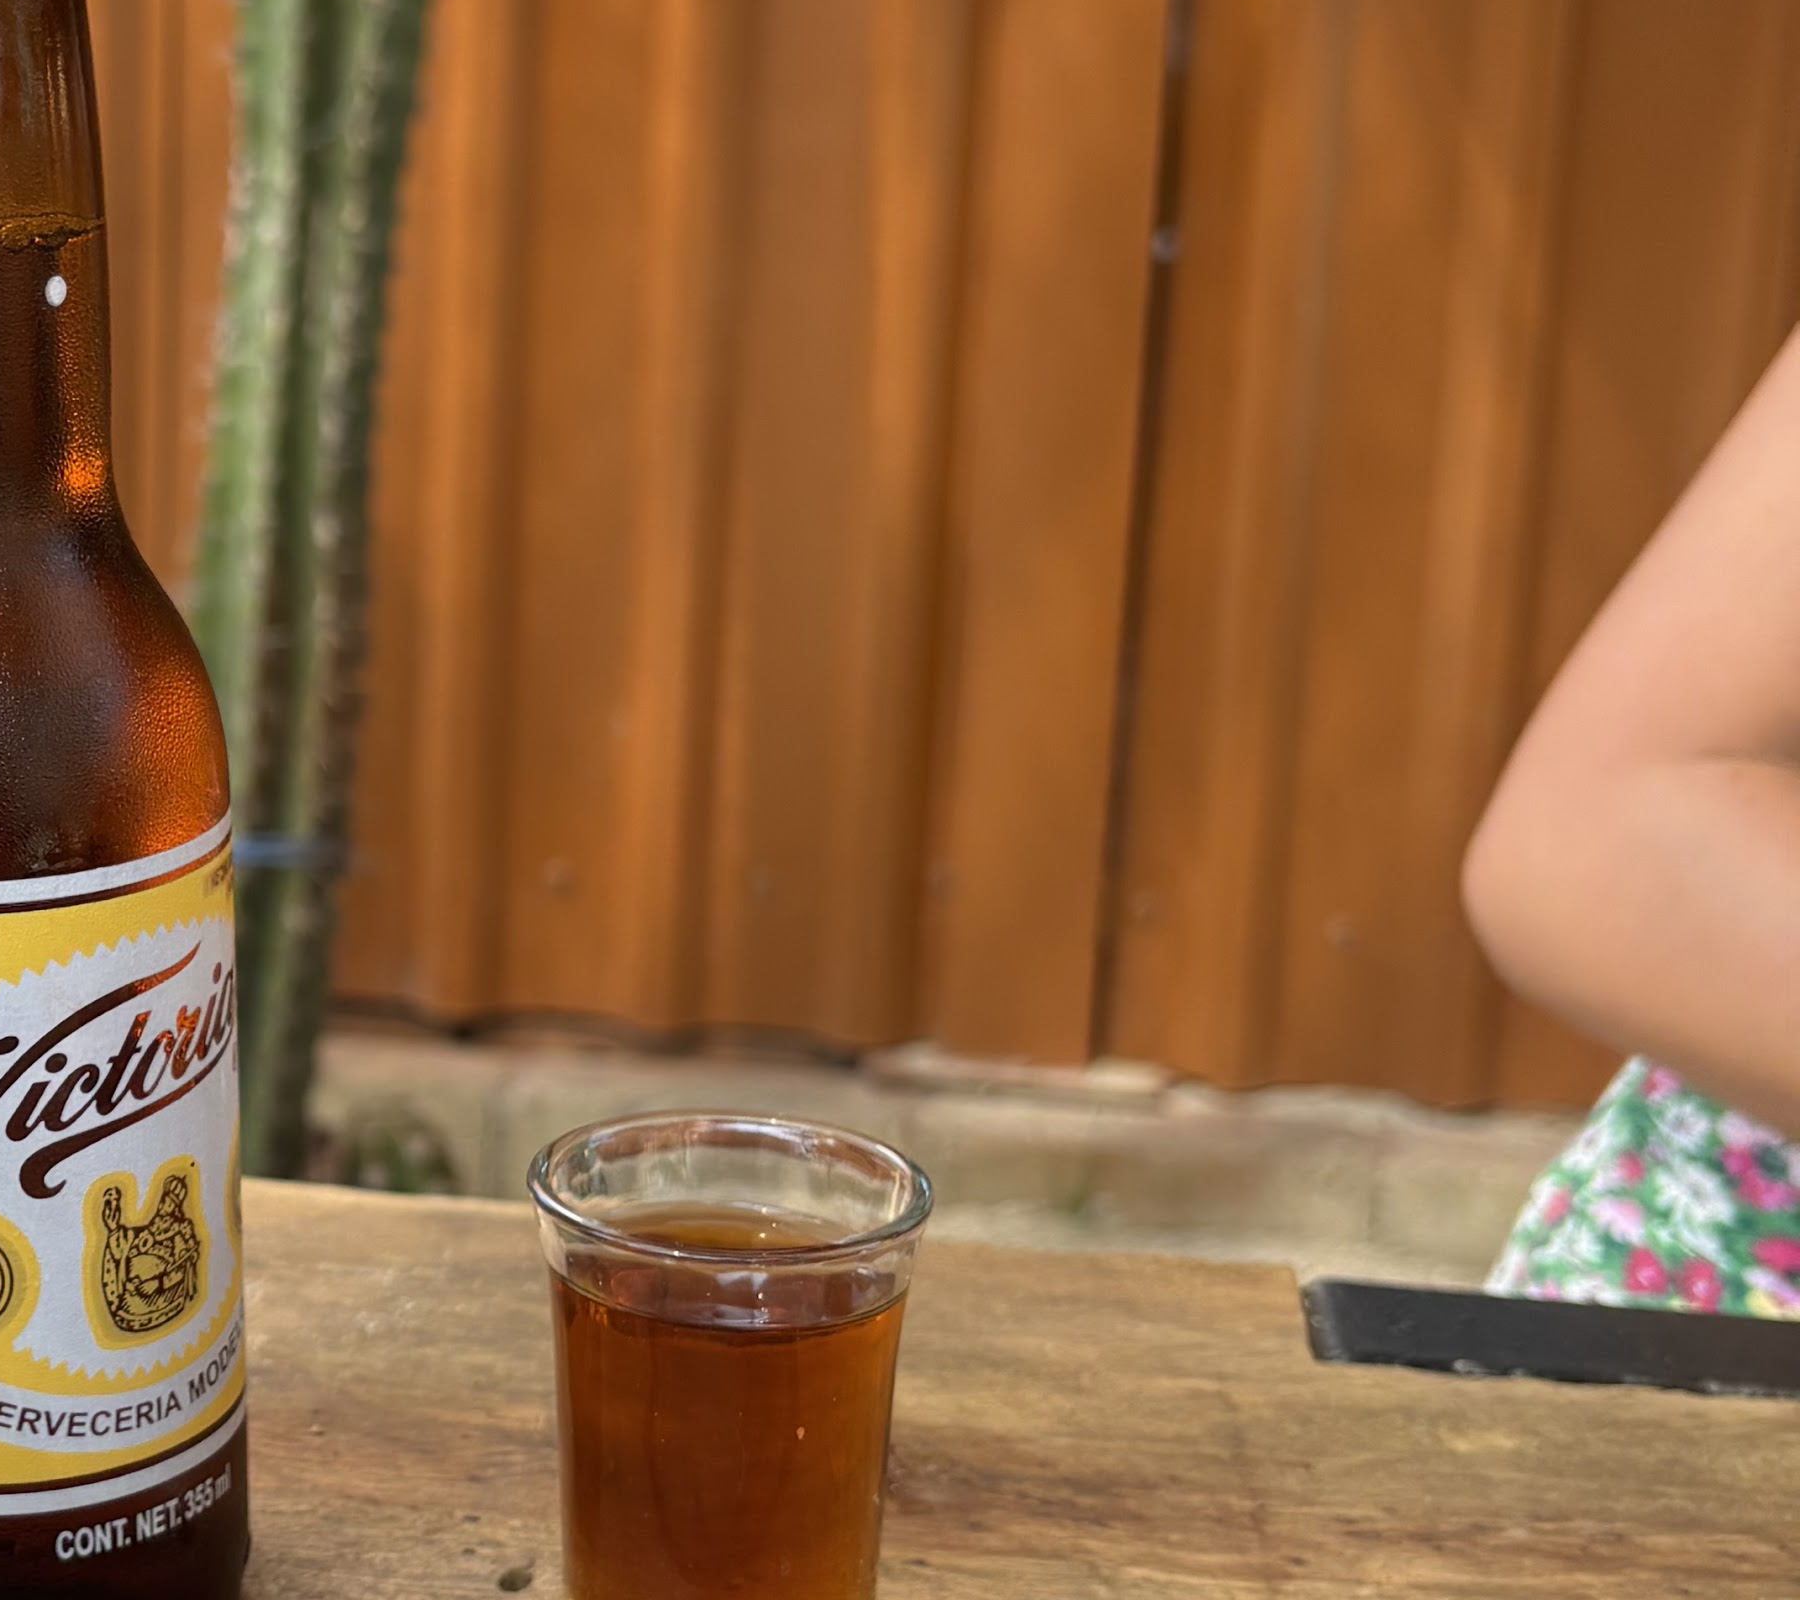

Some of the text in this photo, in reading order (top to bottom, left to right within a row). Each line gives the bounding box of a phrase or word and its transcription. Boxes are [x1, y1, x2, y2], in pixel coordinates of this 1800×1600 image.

[55, 1517, 132, 1561] CONT.
[135, 1496, 183, 1542] NET.
[184, 1476, 214, 1521] 355
